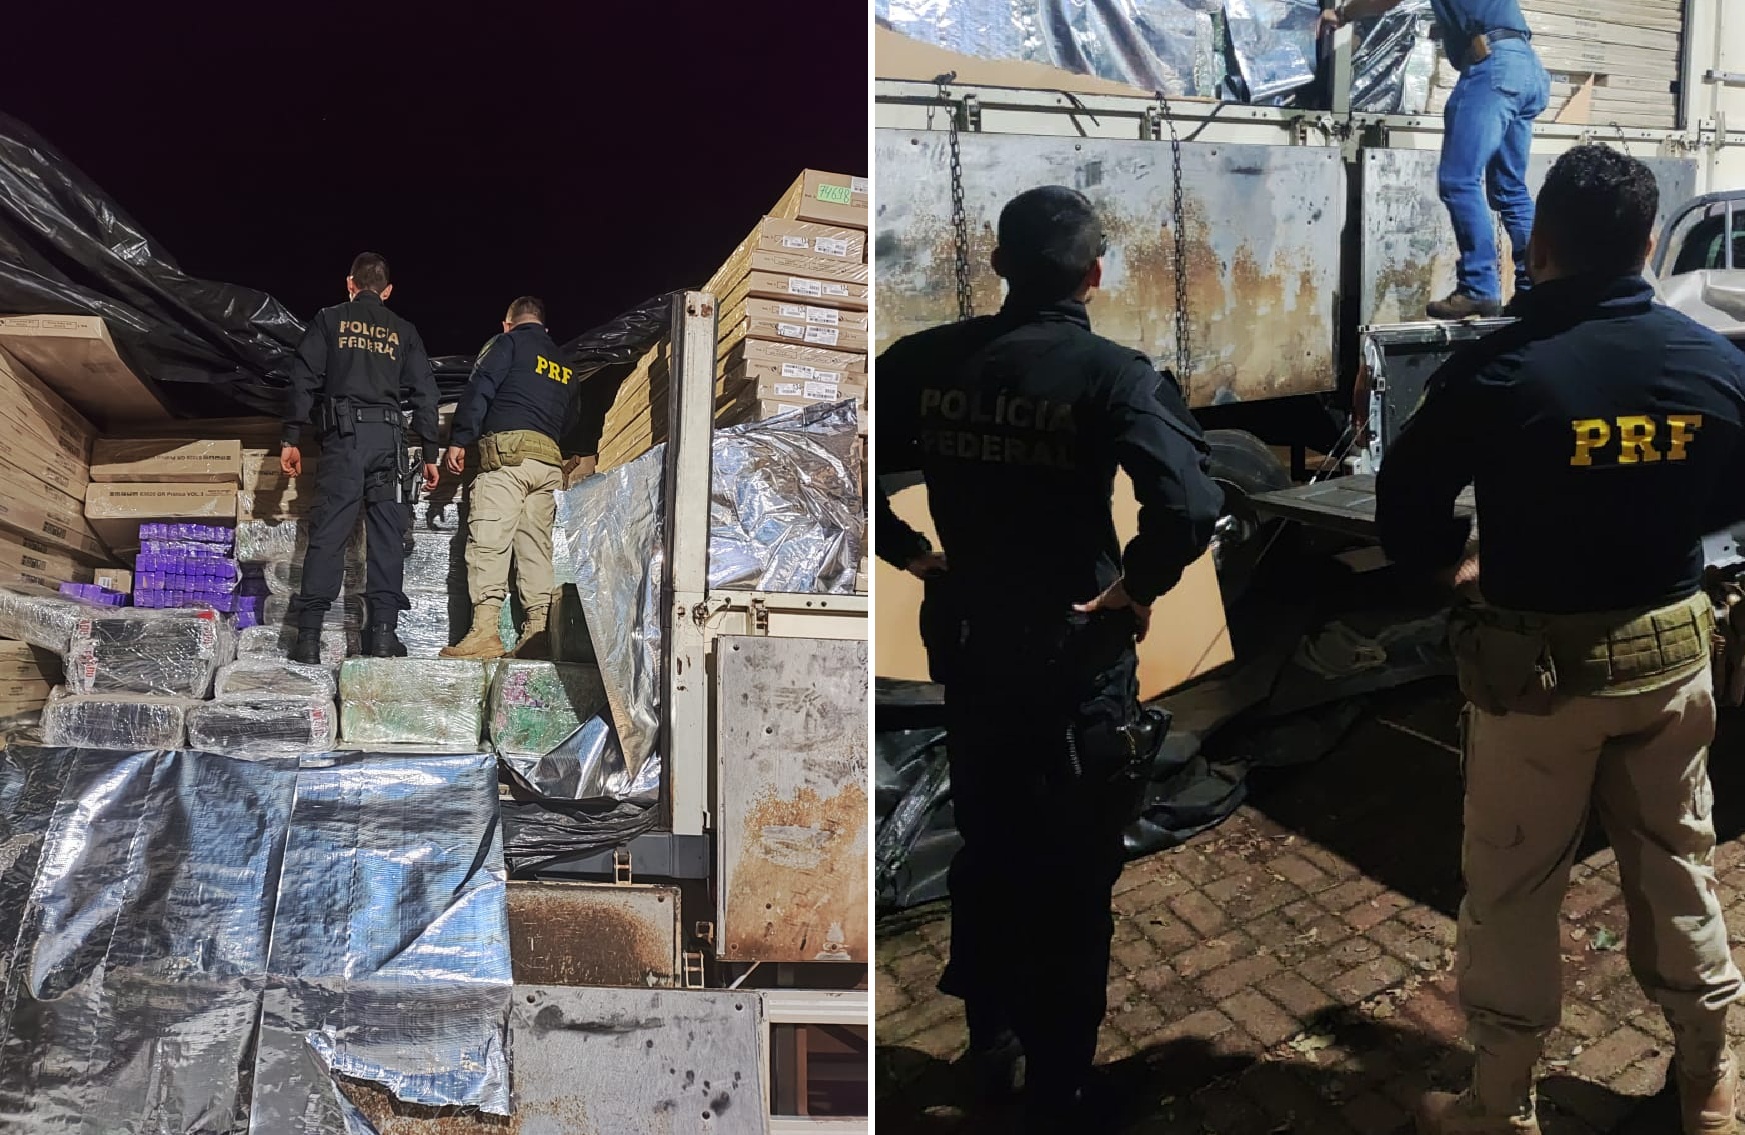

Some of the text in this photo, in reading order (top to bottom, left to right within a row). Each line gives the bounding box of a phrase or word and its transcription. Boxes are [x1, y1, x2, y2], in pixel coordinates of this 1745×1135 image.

[338, 336, 396, 361] FEDERAL
[535, 355, 573, 385] PRF
[920, 430, 1076, 471] FEDERAL
[1570, 414, 1702, 466] PRF
